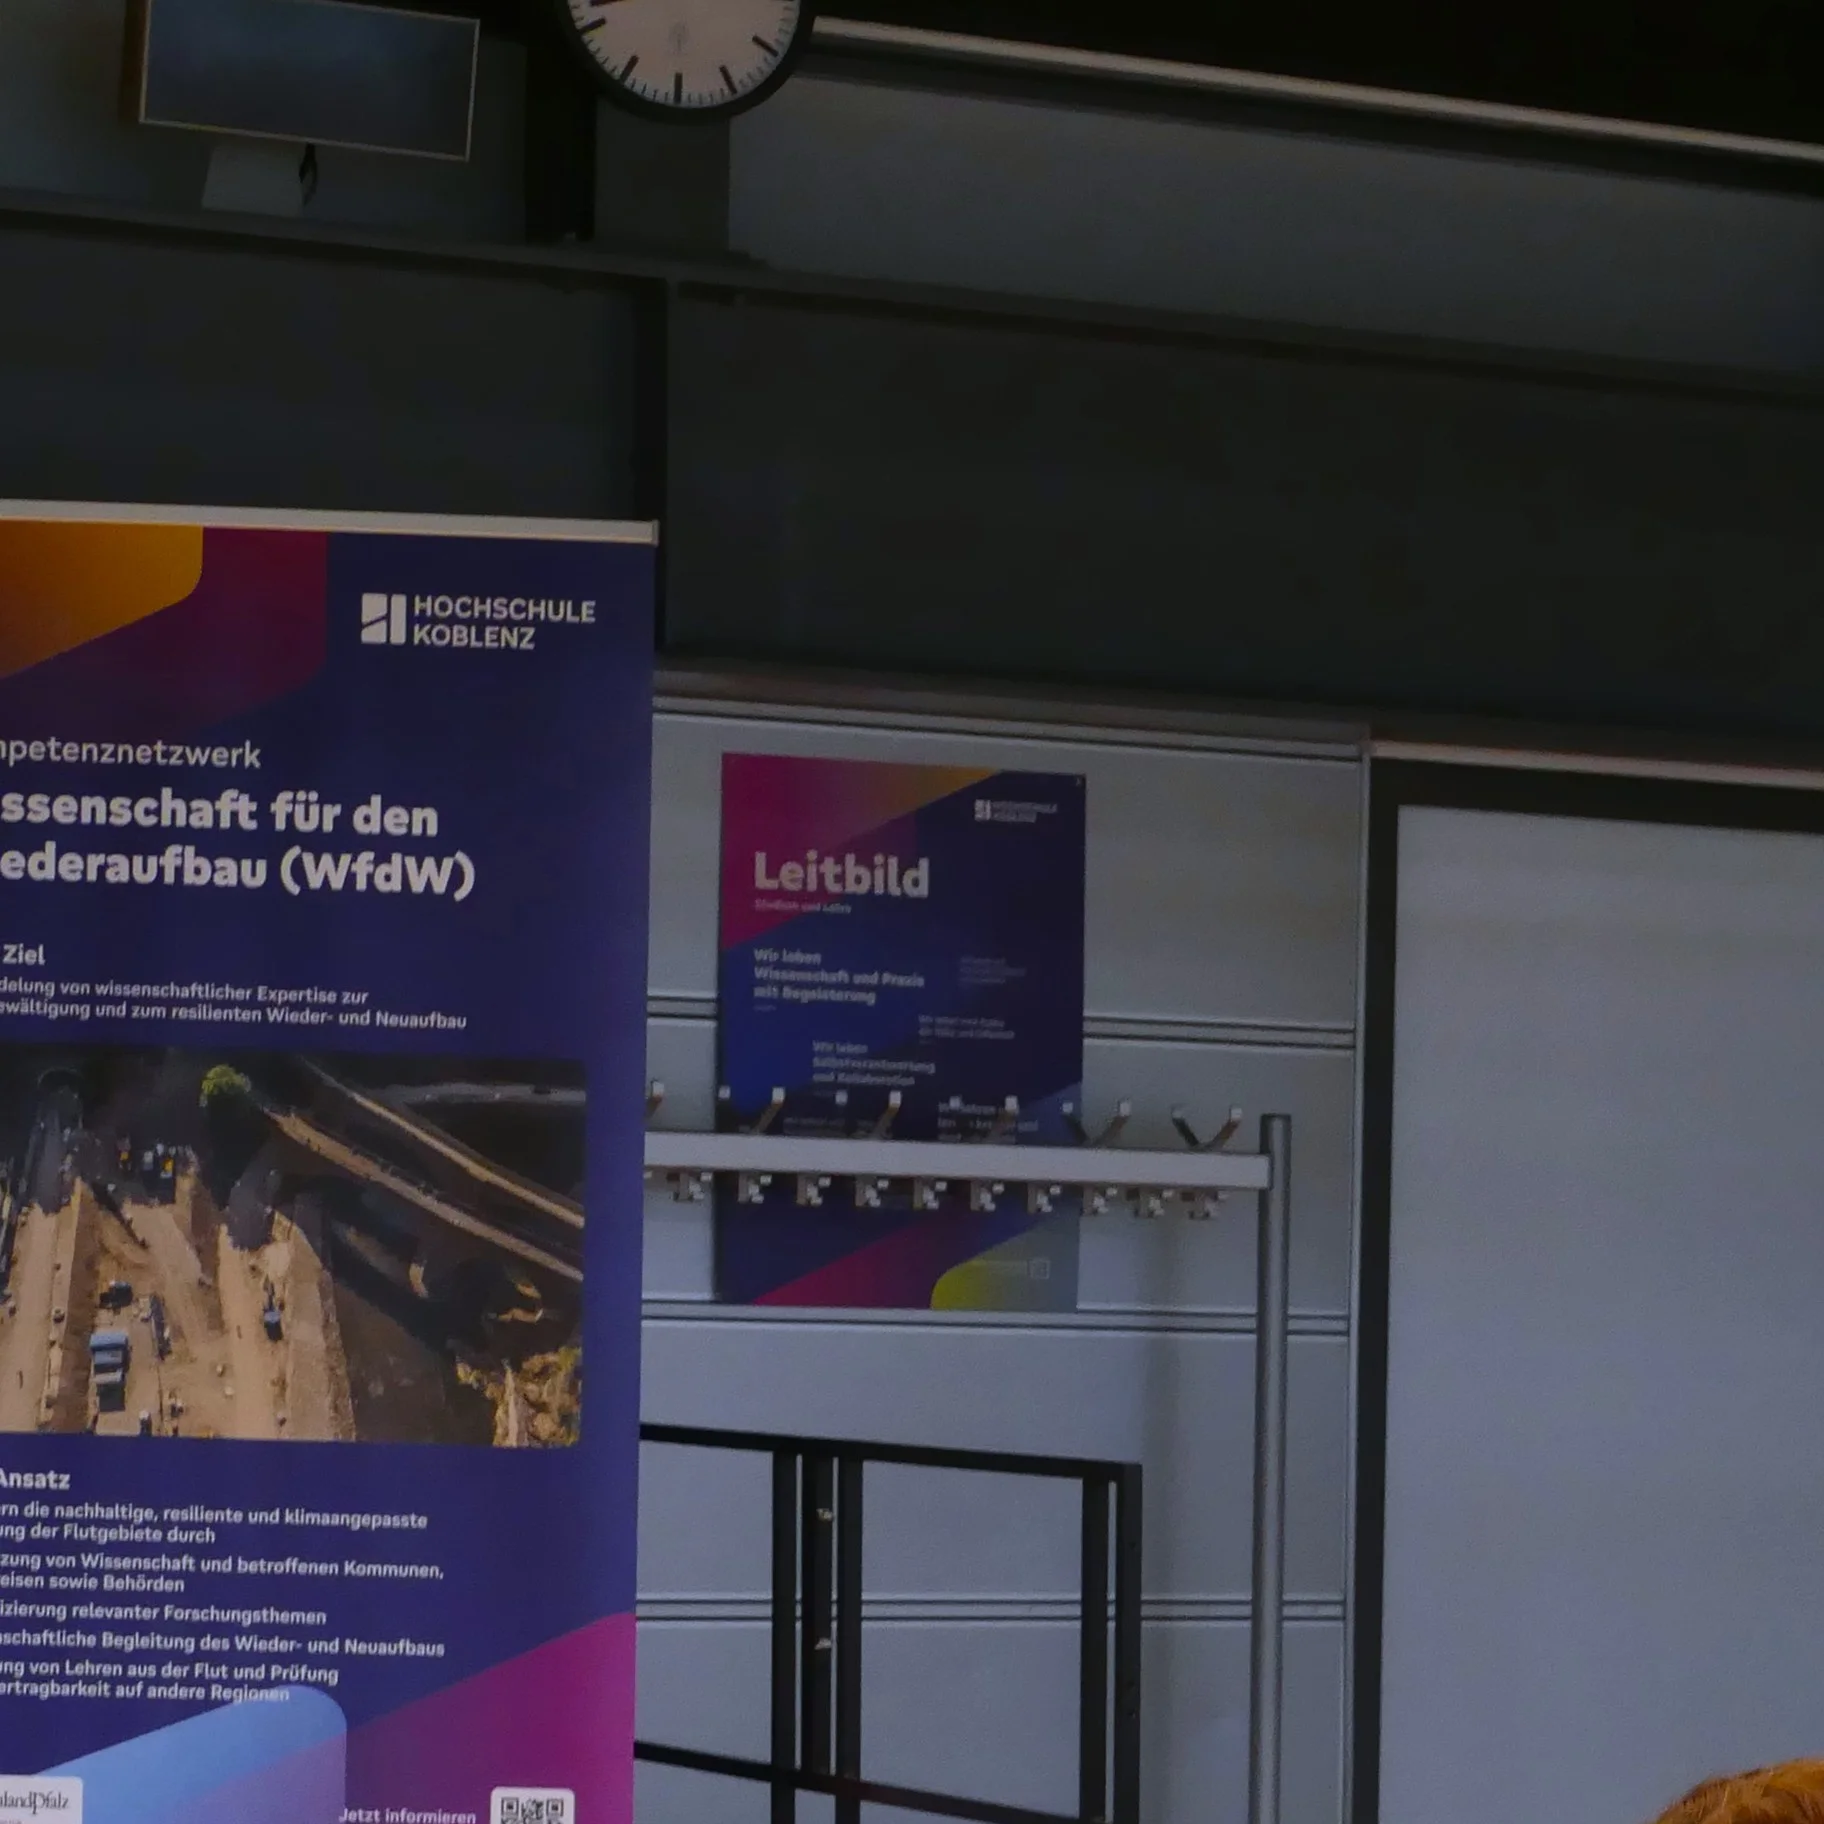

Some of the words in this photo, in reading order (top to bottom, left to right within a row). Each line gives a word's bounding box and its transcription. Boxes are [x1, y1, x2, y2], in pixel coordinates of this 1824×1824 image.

[413, 594, 596, 624] HOCHSCHULE
[413, 623, 536, 650] KOBLENZ
[1, 787, 257, 831] ssenschaft
[270, 790, 342, 833] für
[353, 794, 438, 837] den
[0, 840, 267, 888] ederaufbau
[281, 845, 475, 901] (WfdW)
[755, 849, 930, 898] Leitbild
[3, 943, 46, 965] Ziel
[60, 982, 90, 995] von
[95, 980, 252, 1001] wissenschaftlicher
[257, 985, 337, 1005] Expertise
[342, 990, 369, 1004] zur
[95, 1001, 126, 1018] und
[131, 1005, 166, 1020] zum
[171, 1004, 261, 1023] resilienten
[267, 1006, 333, 1025] Wieder-
[338, 1009, 371, 1026] und
[375, 1010, 467, 1029] Neuaufbau
[24, 1500, 49, 1518] die
[55, 1502, 158, 1524] nachhaltige,
[163, 1504, 243, 1524] resiliente
[248, 1508, 280, 1525] und
[285, 1508, 428, 1531] klimaangepasste
[30, 1521, 59, 1540] der
[63, 1523, 163, 1545] Flutgebiete
[167, 1527, 216, 1544] durch
[46, 1555, 76, 1569] von
[80, 1552, 195, 1572] Wissenschaft
[201, 1555, 232, 1573] und
[238, 1556, 339, 1576] betroffenen
[345, 1559, 444, 1580] Kommunen,
[49, 1572, 98, 1590] sowie
[103, 1573, 185, 1593] Behörden
[72, 1602, 159, 1621] relevanter
[164, 1604, 327, 1627] Forschungsthemen
[0, 1628, 97, 1648] schaftliche
[102, 1631, 195, 1653] Begleitung
[200, 1634, 230, 1650] des
[235, 1635, 303, 1653] Wieder-
[308, 1637, 339, 1654] und
[345, 1638, 445, 1657] Neuaufbaus
[30, 1661, 60, 1675] von
[65, 1659, 122, 1677] Lehren
[127, 1664, 157, 1677] aus
[161, 1661, 189, 1679] der
[194, 1662, 228, 1680] Flut
[234, 1664, 265, 1680] und
[271, 1664, 339, 1686] Prüfung
[115, 1681, 143, 1698] auf
[147, 1682, 205, 1699] andere
[210, 1684, 290, 1704] Regionen
[339, 1807, 380, 1823] Jetzt
[385, 1808, 476, 1824] informieren
